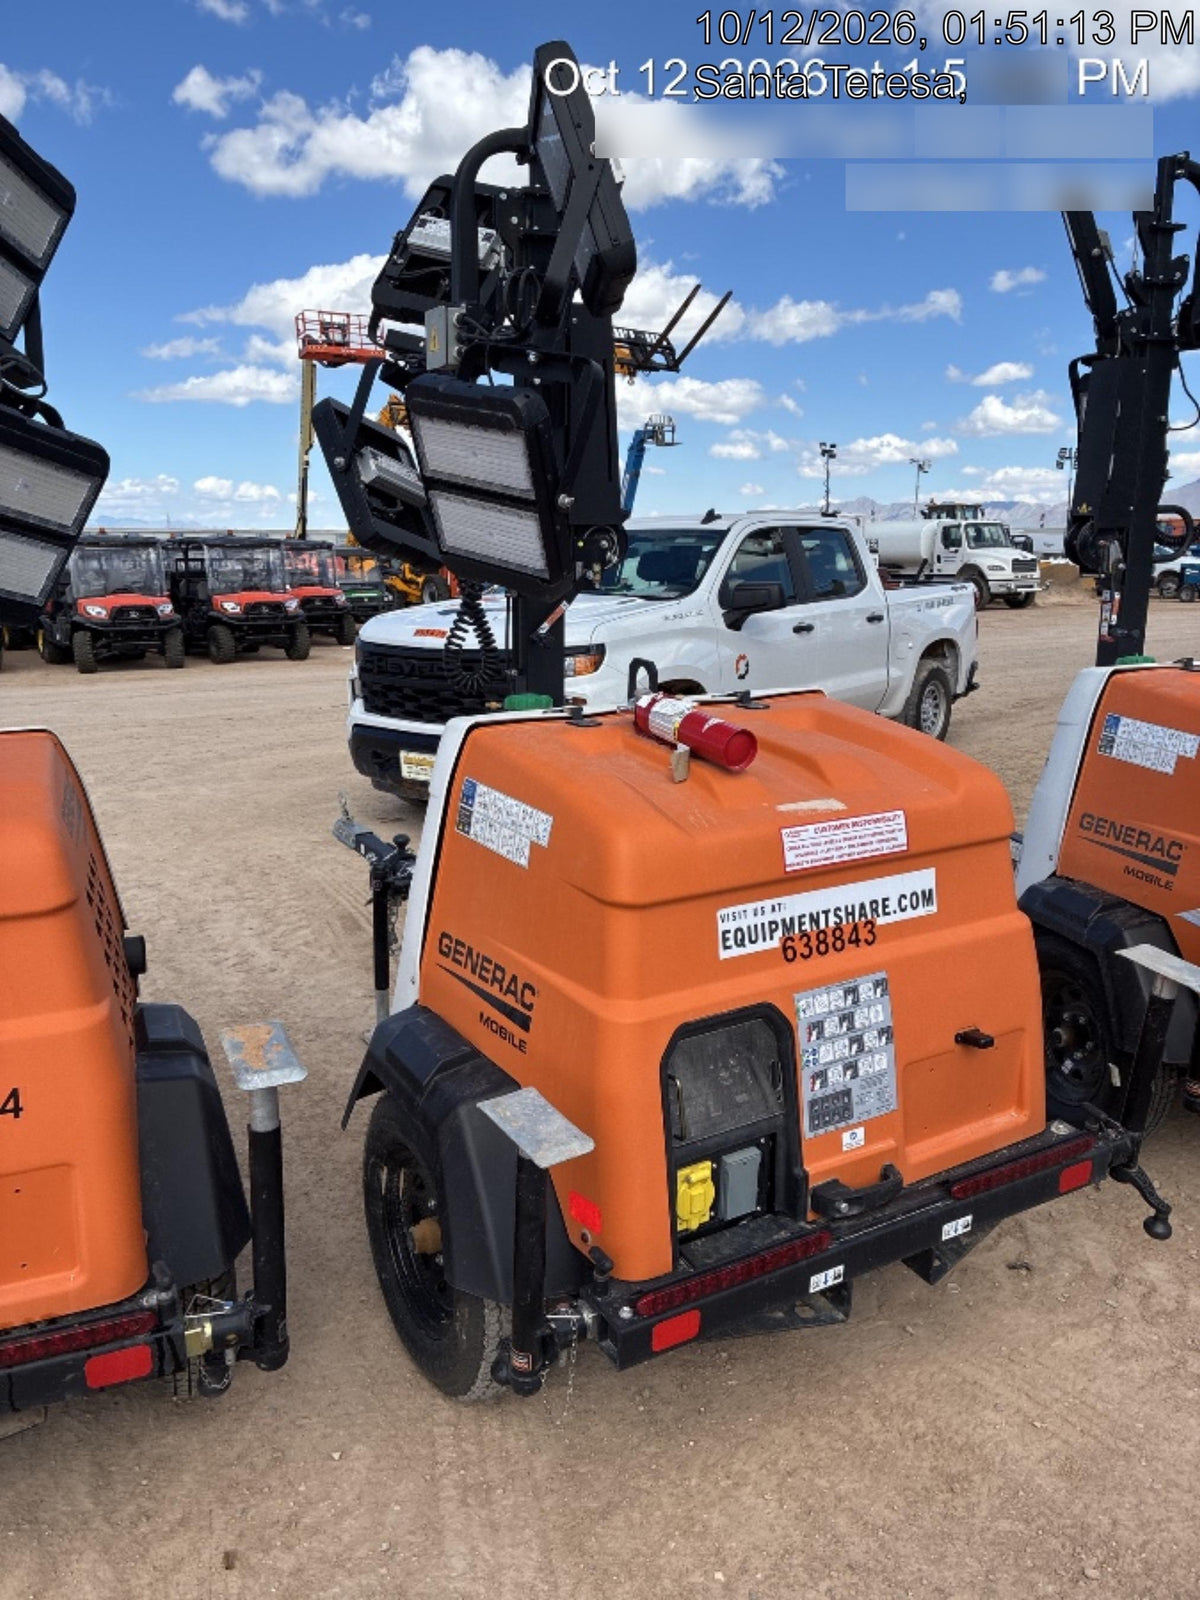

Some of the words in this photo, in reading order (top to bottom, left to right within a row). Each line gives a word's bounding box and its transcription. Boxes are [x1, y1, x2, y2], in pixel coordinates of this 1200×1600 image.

[1079, 812, 1184, 862] GENERAC
[1123, 865, 1175, 891] MOBILE
[719, 909, 748, 924] VISIT
[753, 906, 766, 917] US
[770, 902, 787, 914] AT:
[720, 887, 935, 951] EQUIPMENTSHARE.COM
[781, 919, 878, 963] 638843
[438, 930, 537, 1012] GENERAC
[479, 1010, 528, 1055] MOBILE
